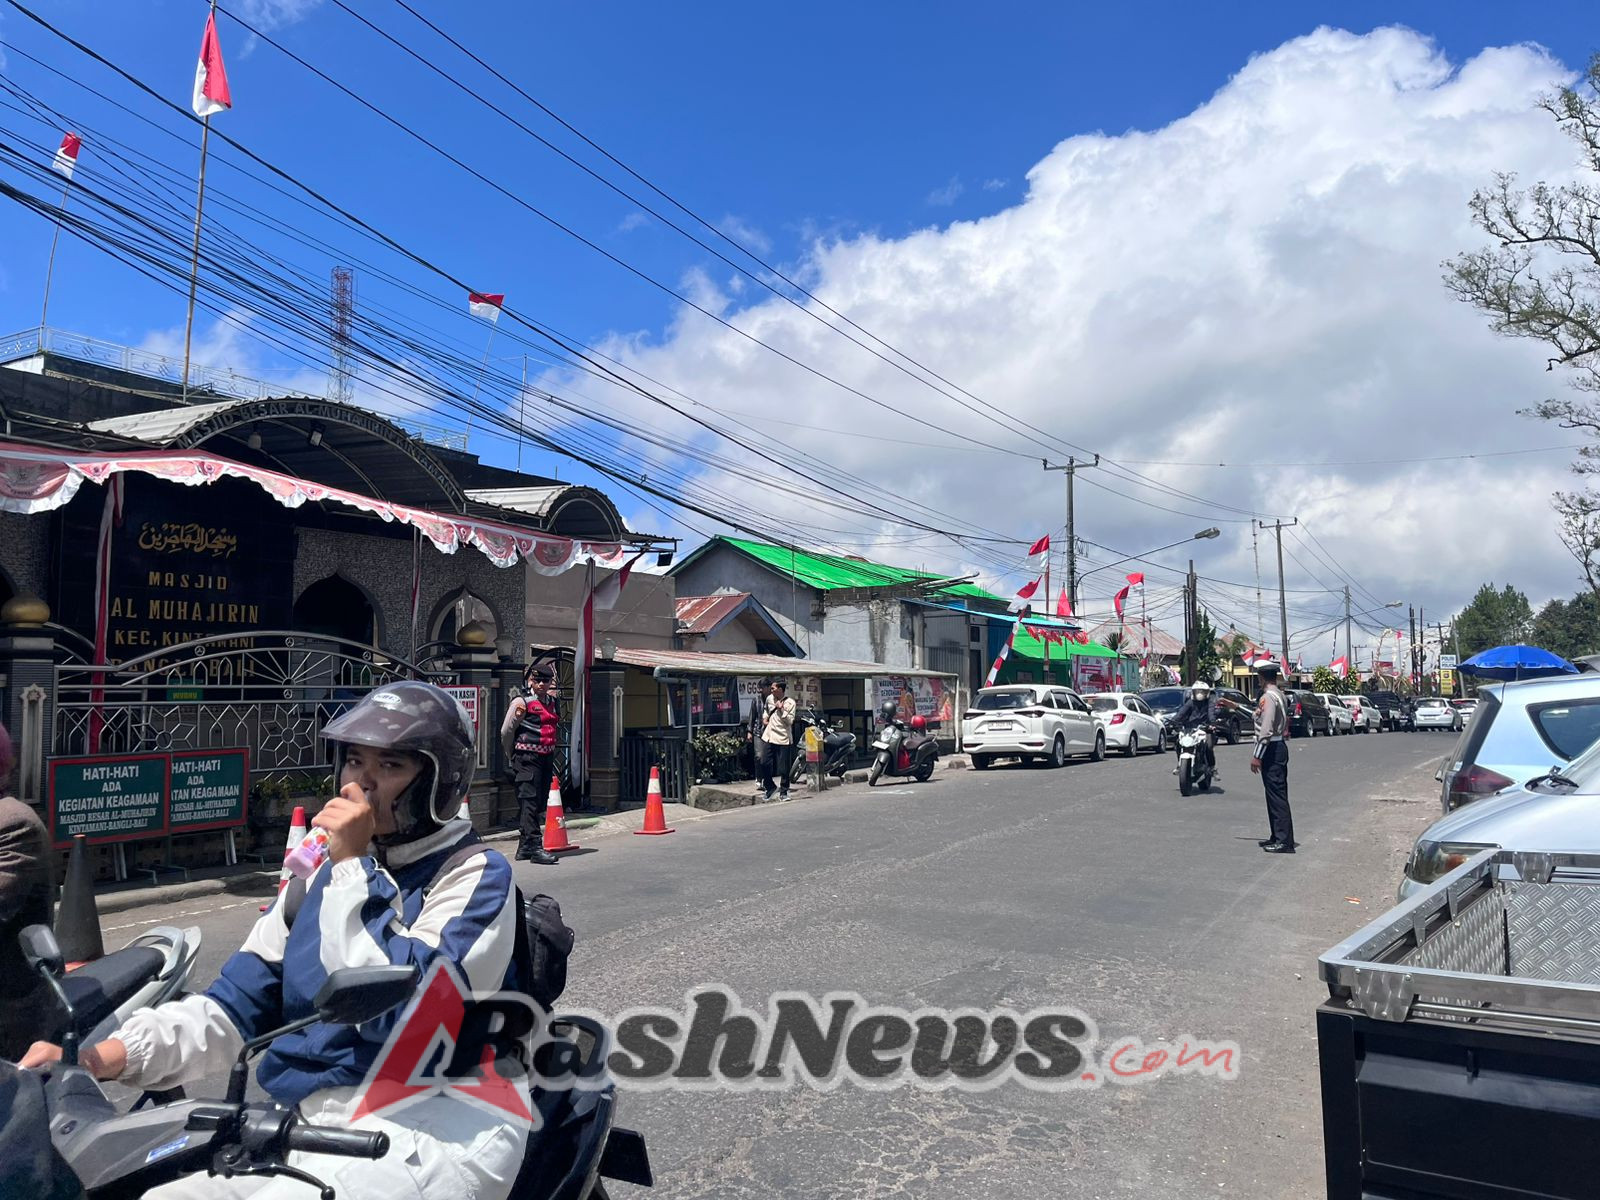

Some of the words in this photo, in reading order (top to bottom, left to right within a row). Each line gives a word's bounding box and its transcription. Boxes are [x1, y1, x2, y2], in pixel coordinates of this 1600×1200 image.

[176, 413, 235, 450] MASJID
[240, 402, 289, 421] BESAR
[149, 571, 228, 590] MASJID
[111, 597, 137, 618] AL
[149, 600, 259, 624] MUHAJIRIN
[459, 690, 475, 699] KASIH
[83, 765, 139, 781] HATI-HATI
[171, 759, 221, 774] HATI-HATI
[102, 781, 122, 792] ADA
[187, 775, 205, 786] ADA
[191, 784, 240, 799] KEAGAMAAN
[59, 797, 104, 812] KEGIATAN
[106, 792, 160, 808] KEAGAMAAN
[174, 802, 194, 812] BESAR
[60, 814, 86, 825] MASJID
[87, 811, 110, 822] BESAR
